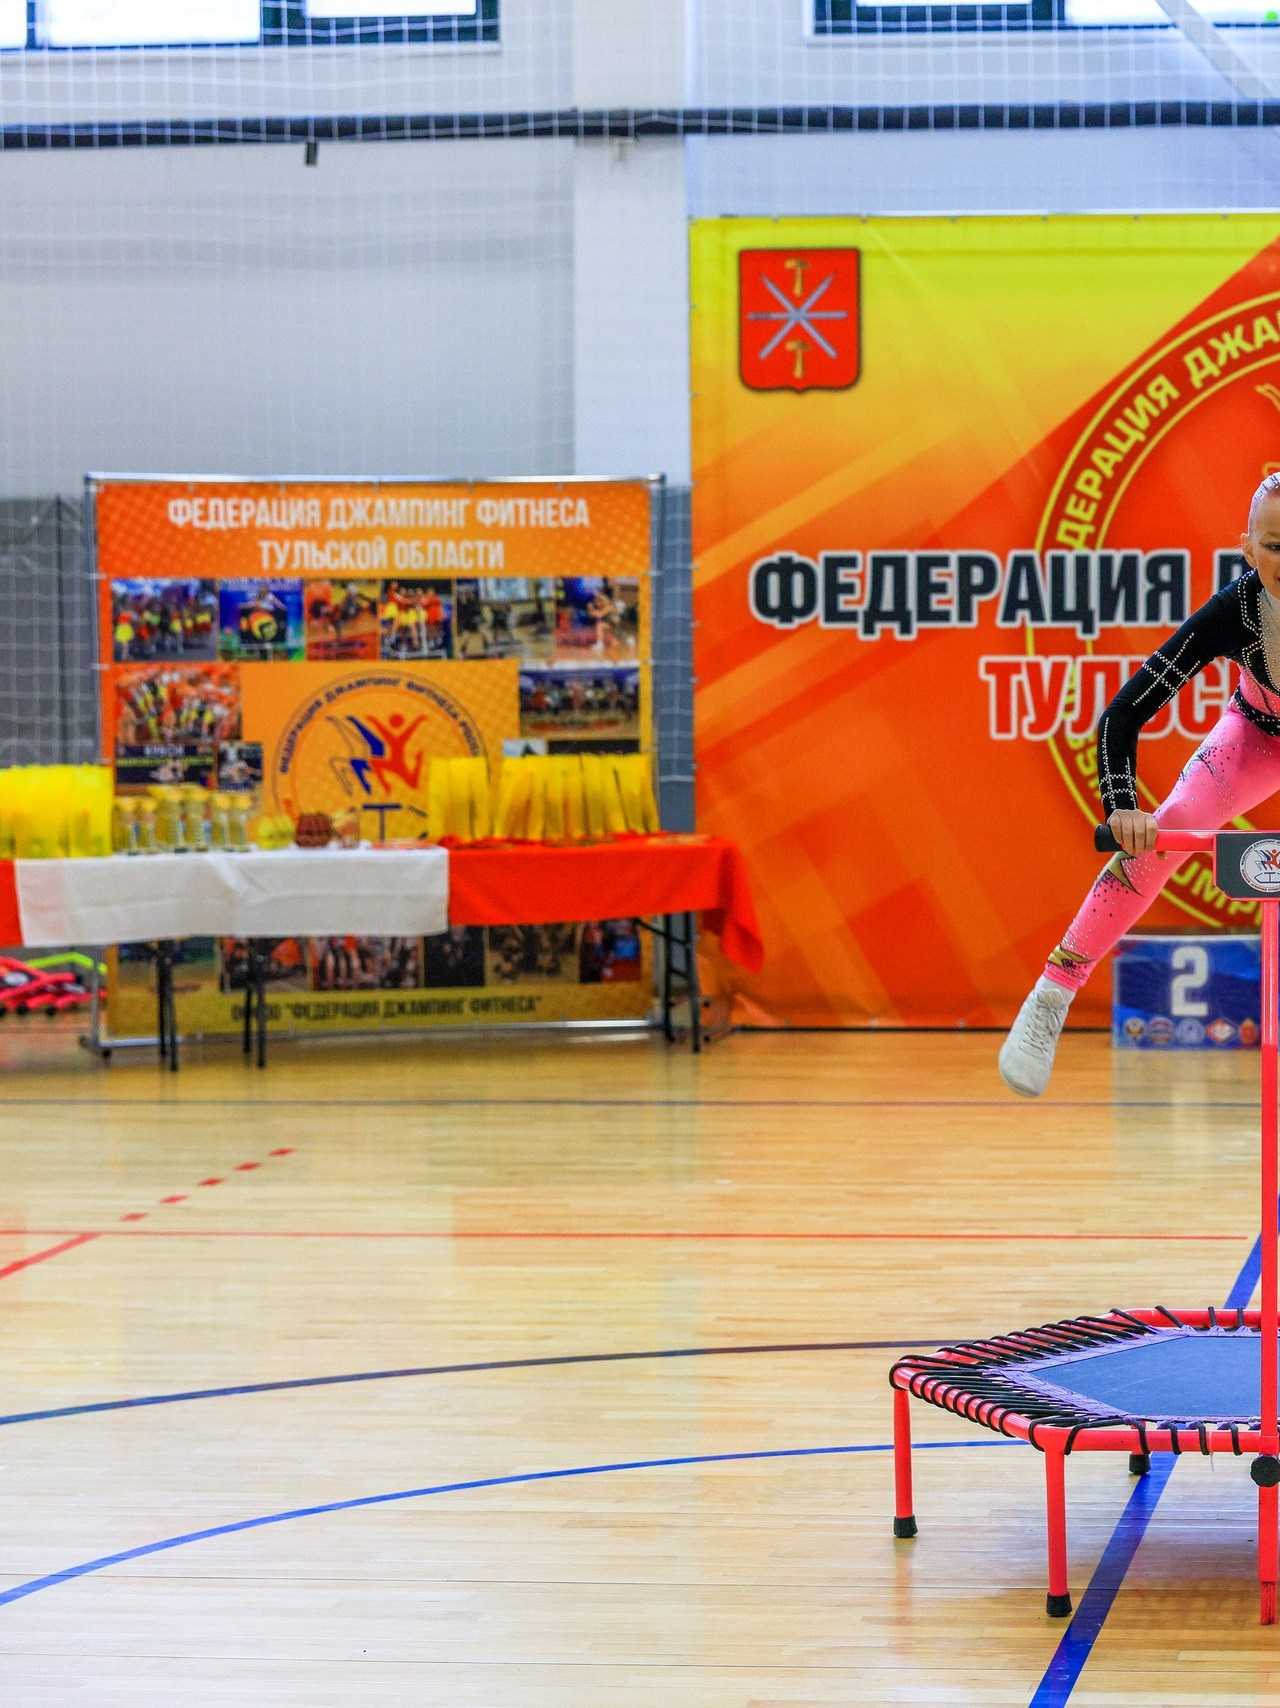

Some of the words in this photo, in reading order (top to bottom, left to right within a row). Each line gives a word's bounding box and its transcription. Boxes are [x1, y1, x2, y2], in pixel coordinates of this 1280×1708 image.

[1055, 374, 1180, 553] ДЕРАЦИЯ
[168, 498, 320, 529] ФЕДЕРАЦИЯ
[327, 498, 471, 529] ДЖАМПИНГ
[476, 498, 591, 527] ФИТНЕСА
[259, 536, 387, 570] ТУЛЬСКОЙ
[393, 539, 506, 570] ОБЛАСТИ
[750, 550, 1190, 641] ФЕДЕРАЦИЯ
[1170, 945, 1209, 1017] 2
